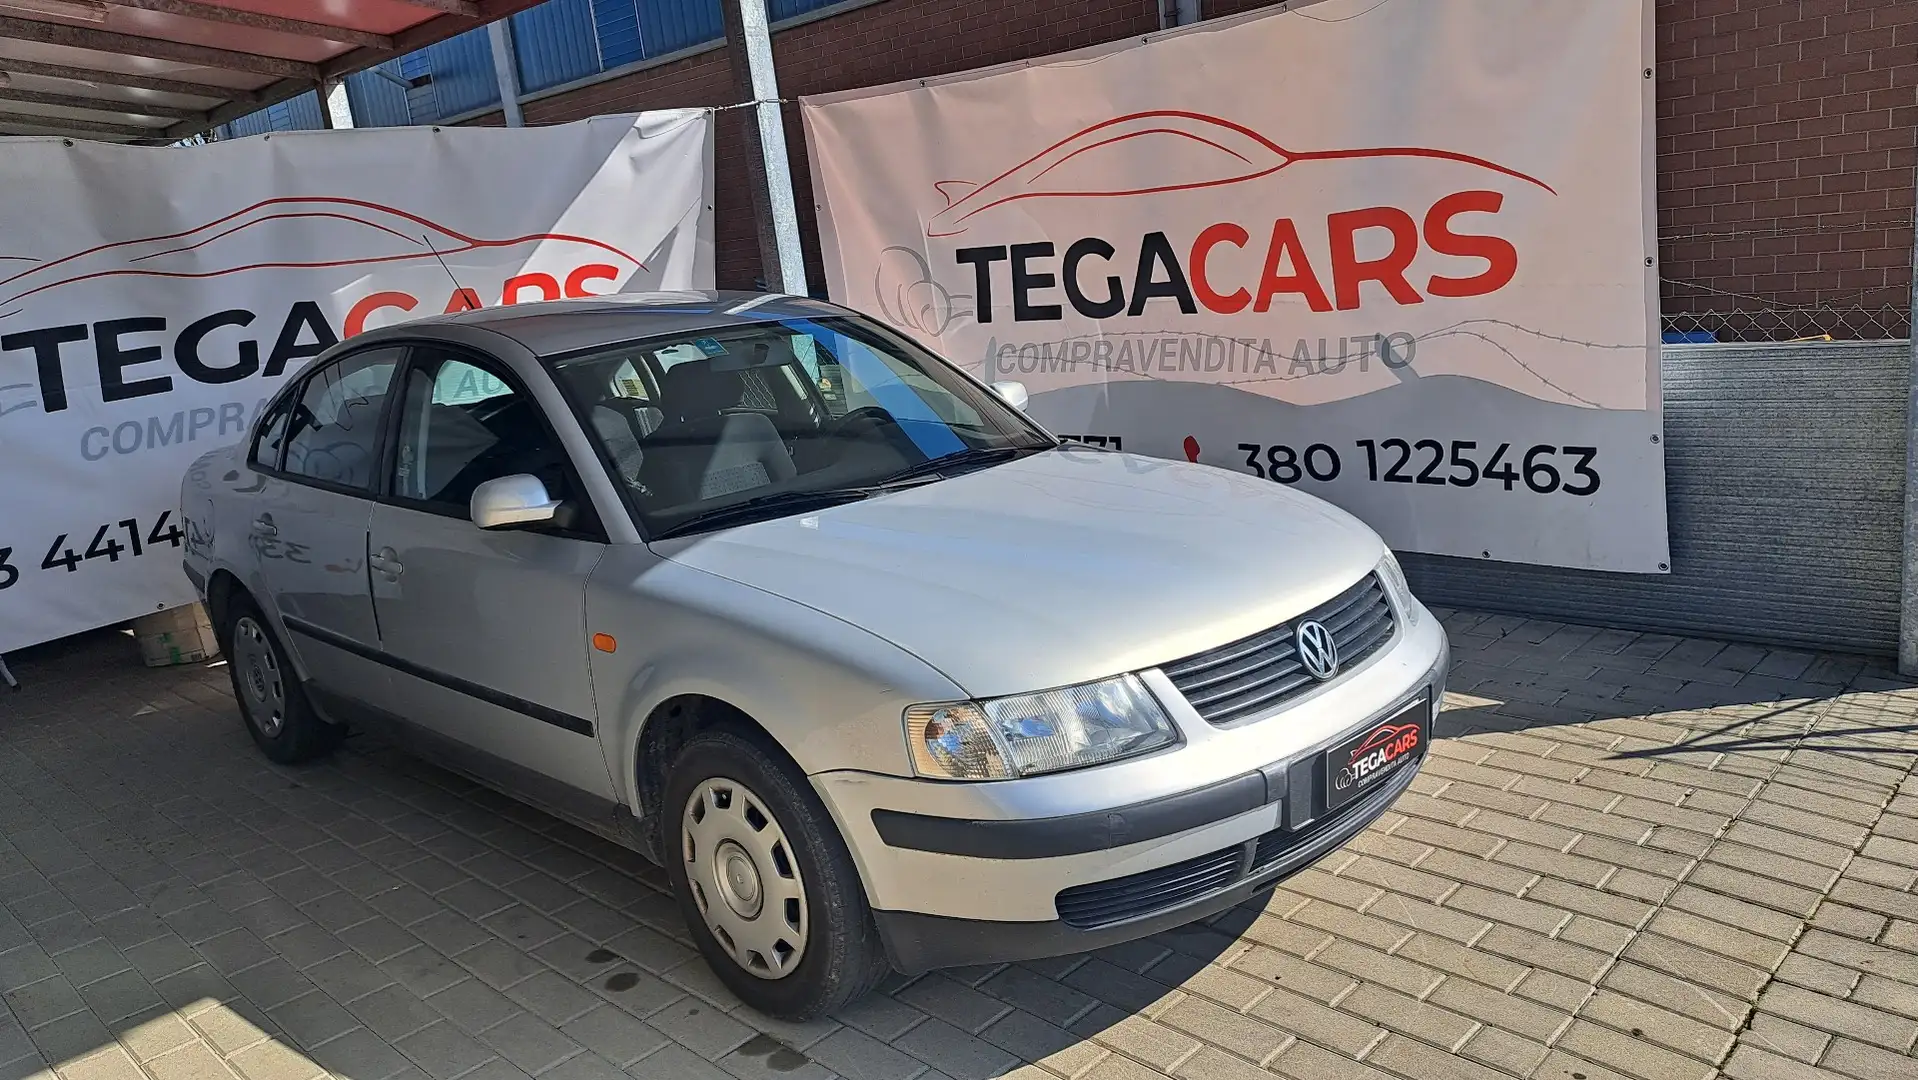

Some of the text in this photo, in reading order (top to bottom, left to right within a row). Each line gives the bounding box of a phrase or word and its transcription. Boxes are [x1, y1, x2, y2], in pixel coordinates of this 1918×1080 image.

[955, 190, 1518, 324] TEGACARS
[1, 264, 619, 413] TEGAC
[997, 331, 1417, 376] COMPRAVENDITA AUTO
[1238, 438, 1601, 496] 380 1225463
[1352, 729, 1418, 780] TEGACARS
